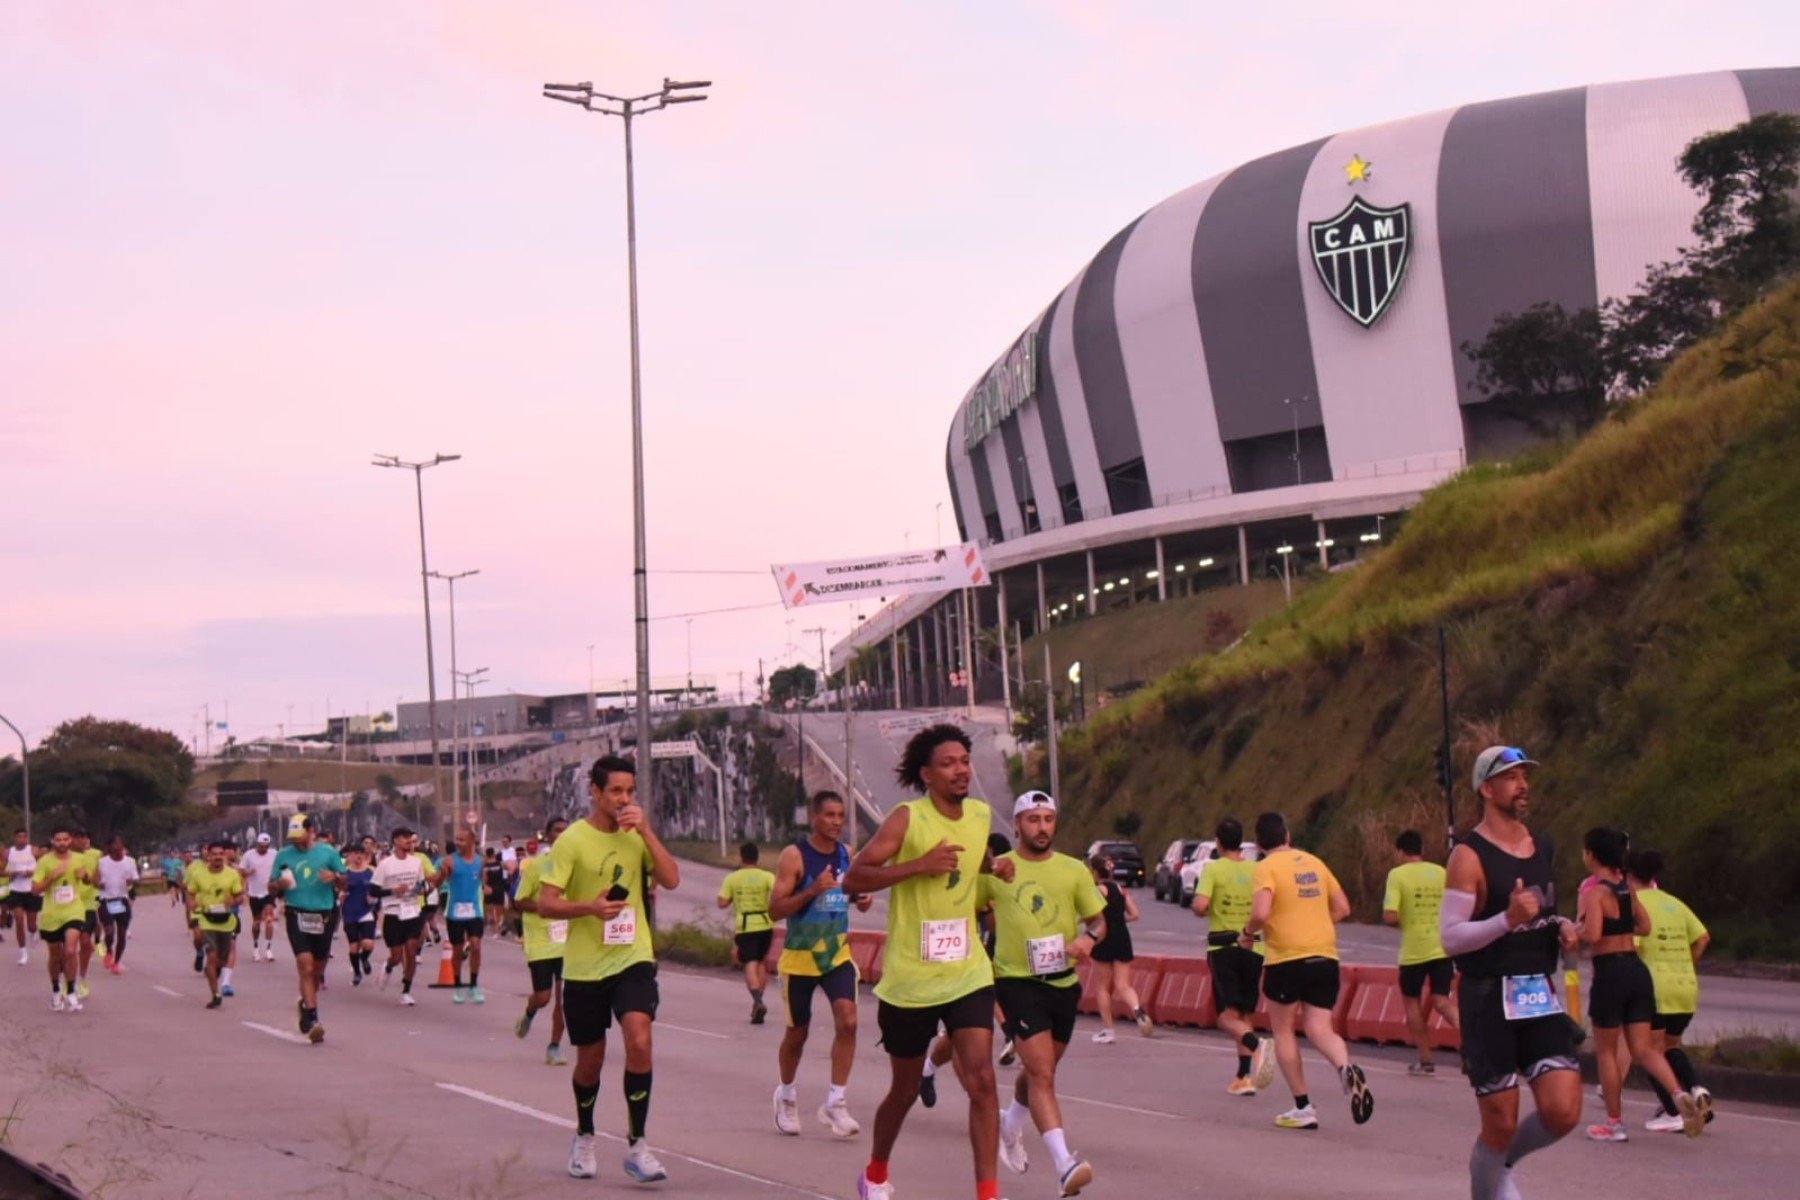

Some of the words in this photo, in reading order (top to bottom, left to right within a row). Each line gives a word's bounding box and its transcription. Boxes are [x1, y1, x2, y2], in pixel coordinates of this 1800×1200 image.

[1324, 217, 1395, 249] CAM
[611, 923, 634, 934] 568
[936, 936, 961, 949] 770
[1040, 950, 1063, 962] 734
[1517, 992, 1548, 1005] 906
